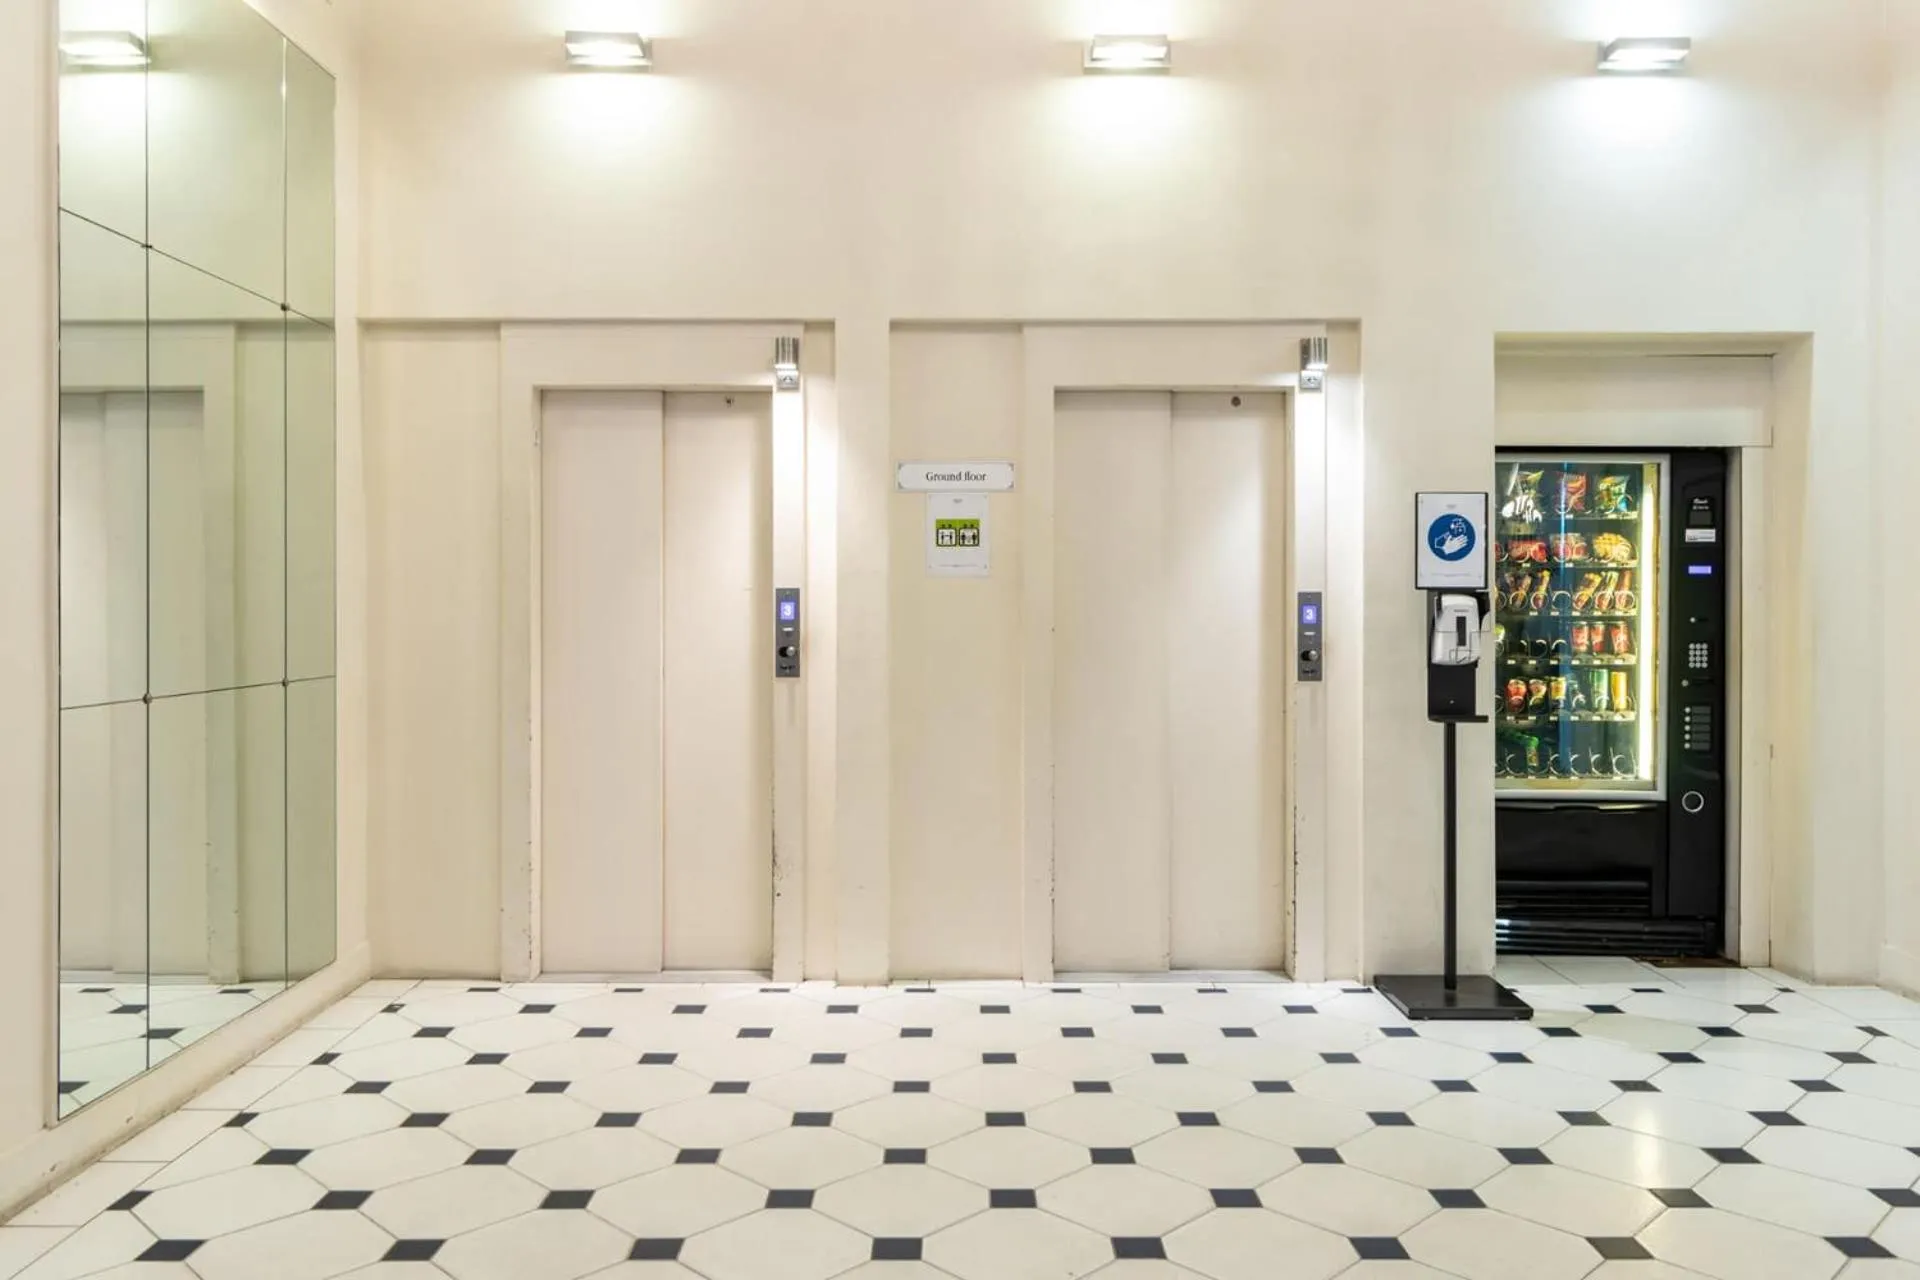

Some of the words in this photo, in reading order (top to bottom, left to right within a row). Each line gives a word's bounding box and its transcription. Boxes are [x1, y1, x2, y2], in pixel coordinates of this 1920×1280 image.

[926, 471, 962, 481] Ground
[964, 471, 986, 481] floor
[783, 604, 792, 616] 3
[1305, 608, 1313, 620] 3
